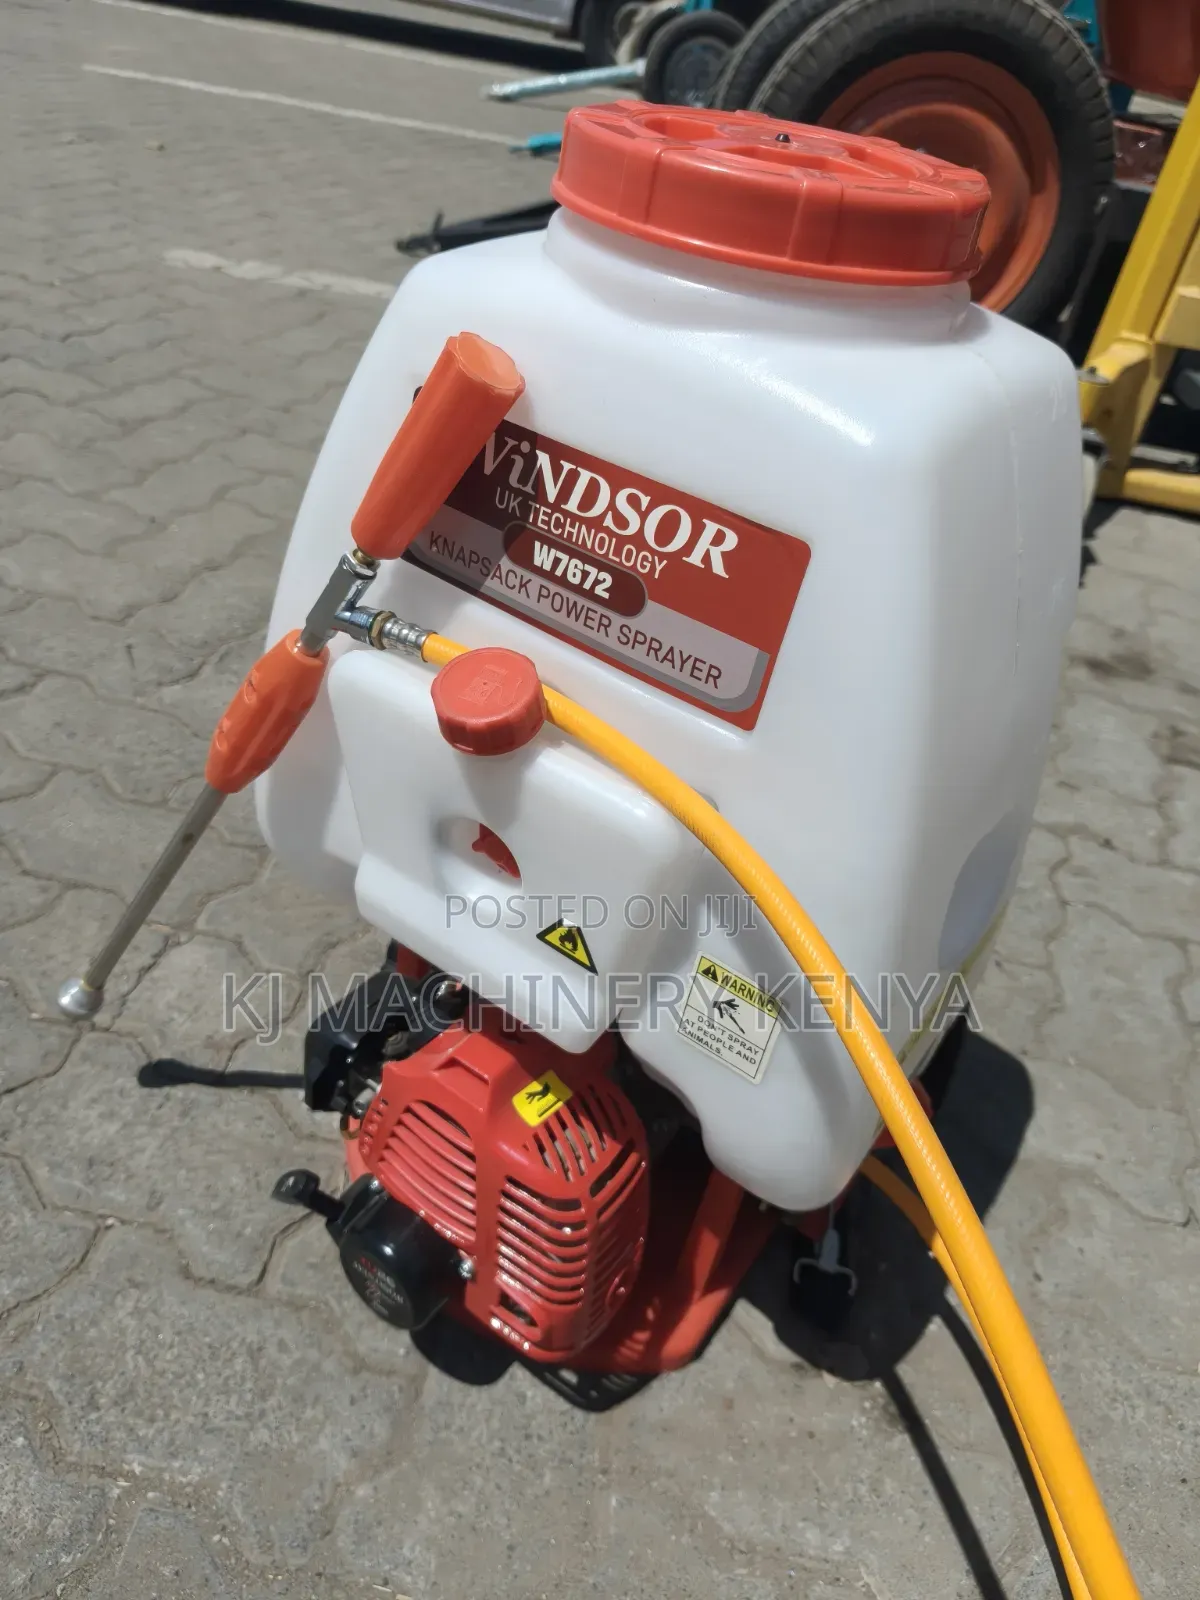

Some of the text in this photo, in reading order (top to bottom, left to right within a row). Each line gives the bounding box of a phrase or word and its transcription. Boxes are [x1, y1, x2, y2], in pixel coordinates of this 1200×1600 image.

[495, 486, 667, 579] UK TECHNOLOGY
[533, 540, 613, 600] W7672
[429, 530, 722, 689] KNAPSACK POWER SPRAYER
[721, 971, 775, 1013] WARNING
[682, 1027, 723, 1056] ANIMALS.
[684, 1018, 756, 1064] AT PEOPLE AND
[697, 1015, 759, 1055] DON'T SPRAY
